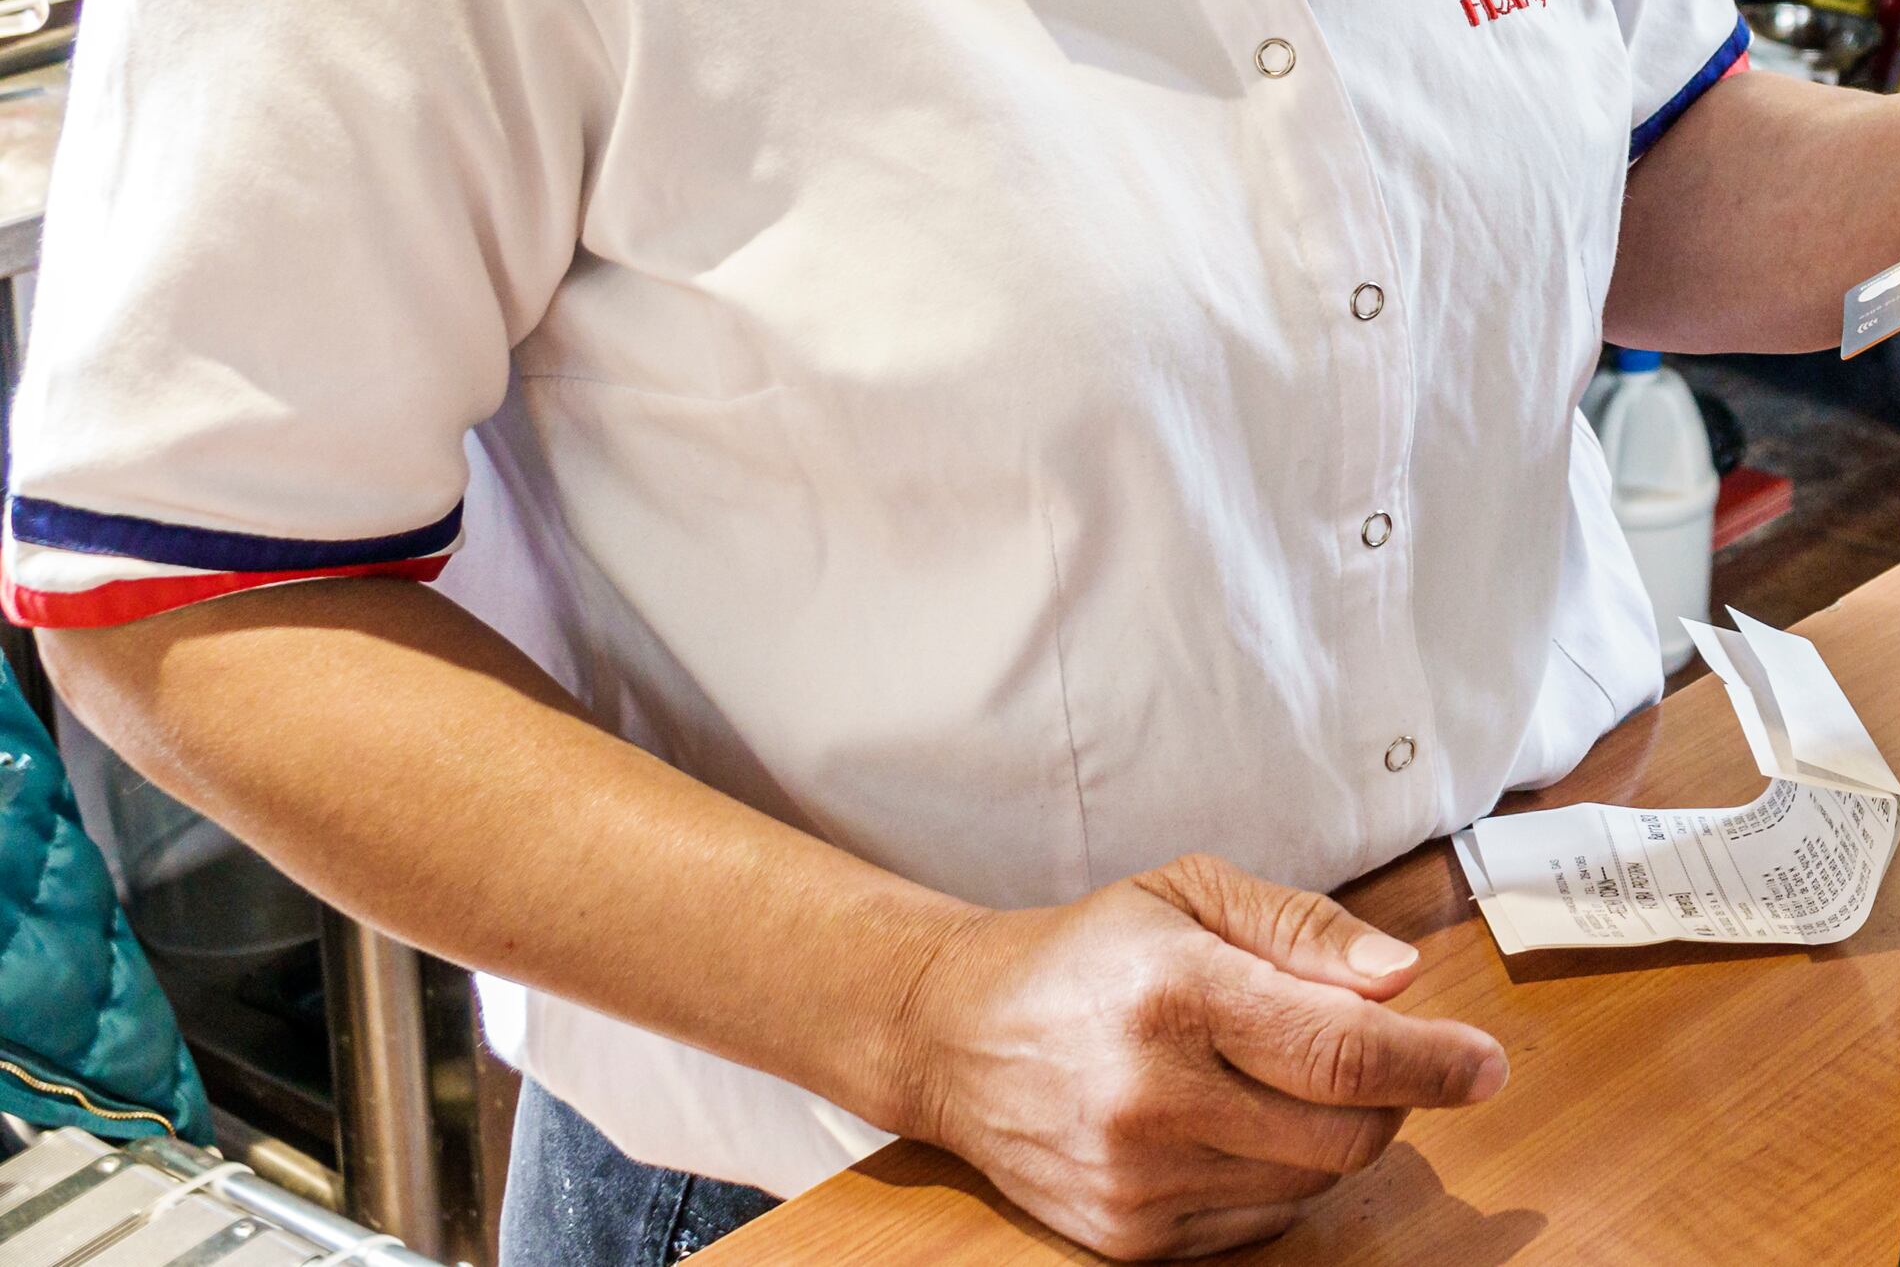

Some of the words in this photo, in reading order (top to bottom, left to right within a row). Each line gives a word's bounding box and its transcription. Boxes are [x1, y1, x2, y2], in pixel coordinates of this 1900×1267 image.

[1819, 868, 1839, 901] Tartaleta
[1828, 858, 1847, 892] Tartaleta
[1811, 877, 1829, 910] Tartaleta
